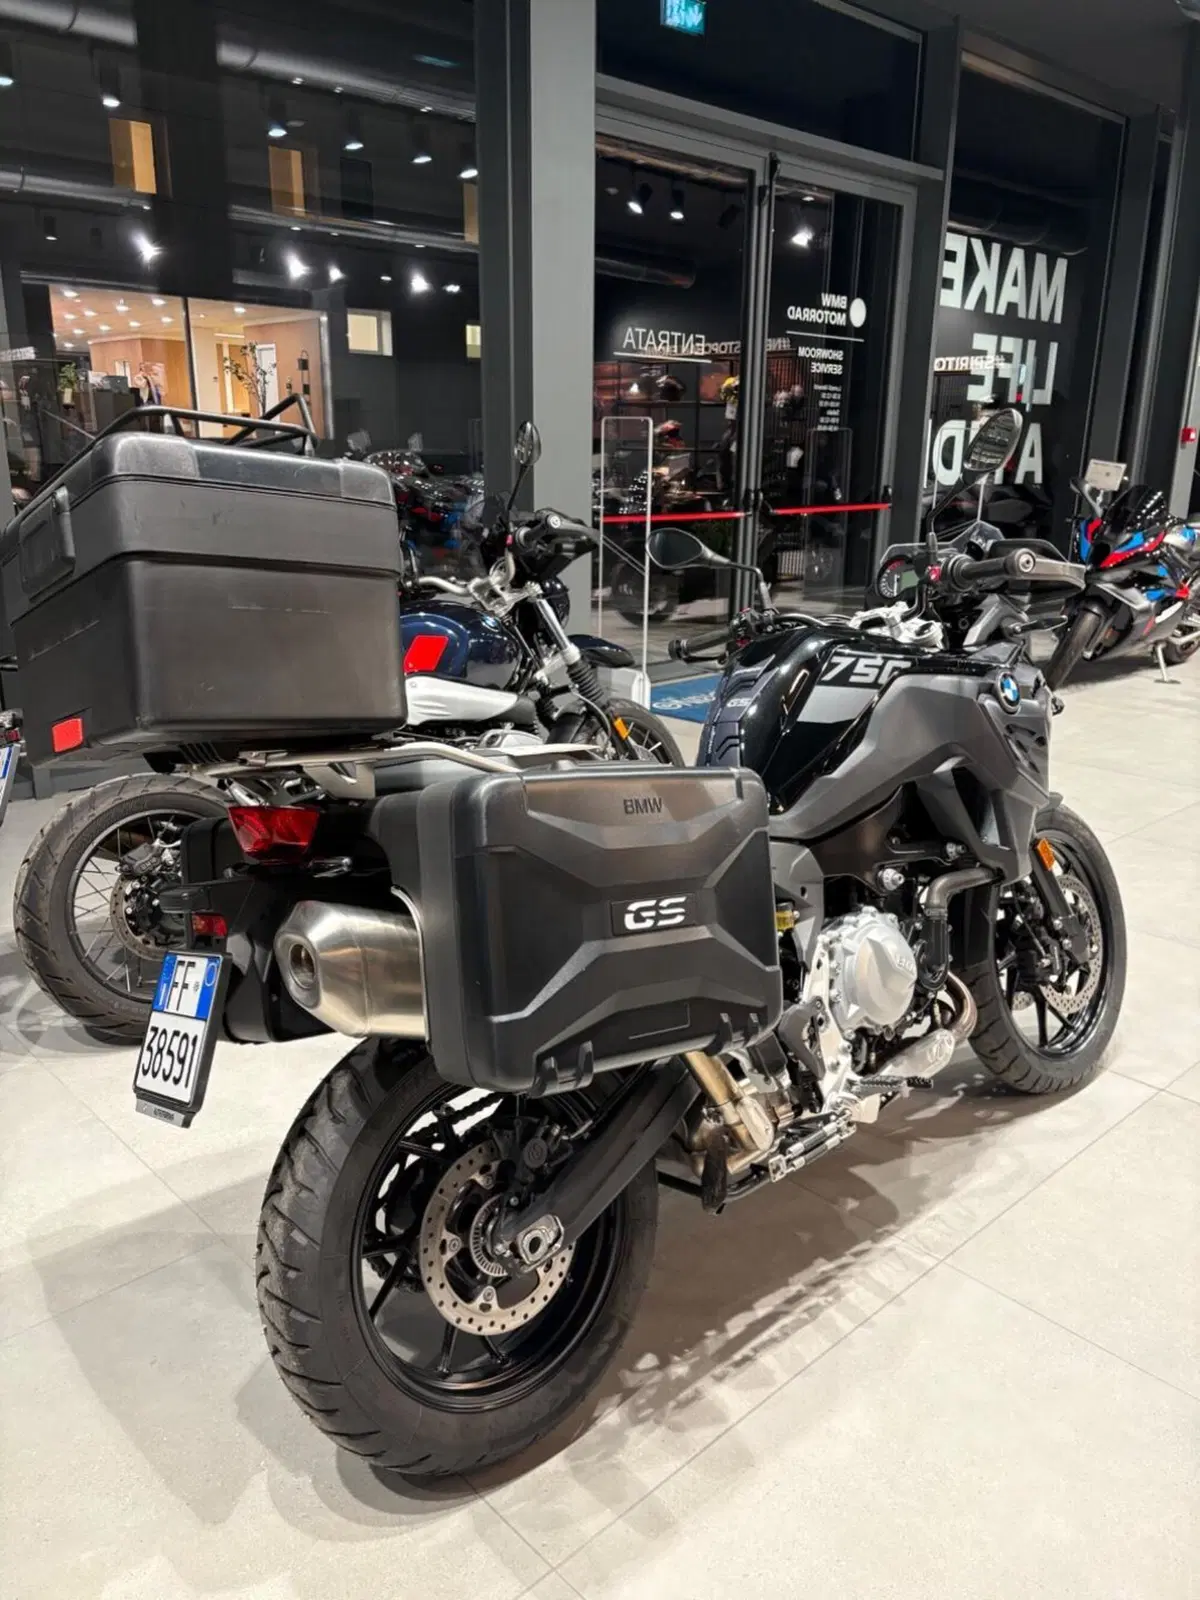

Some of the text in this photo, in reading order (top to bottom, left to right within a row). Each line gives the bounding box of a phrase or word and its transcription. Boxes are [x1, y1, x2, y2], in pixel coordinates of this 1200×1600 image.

[623, 797, 662, 814] BMW
[624, 896, 687, 930] GS
[166, 961, 196, 1011] FF
[142, 1025, 198, 1089] 38591
